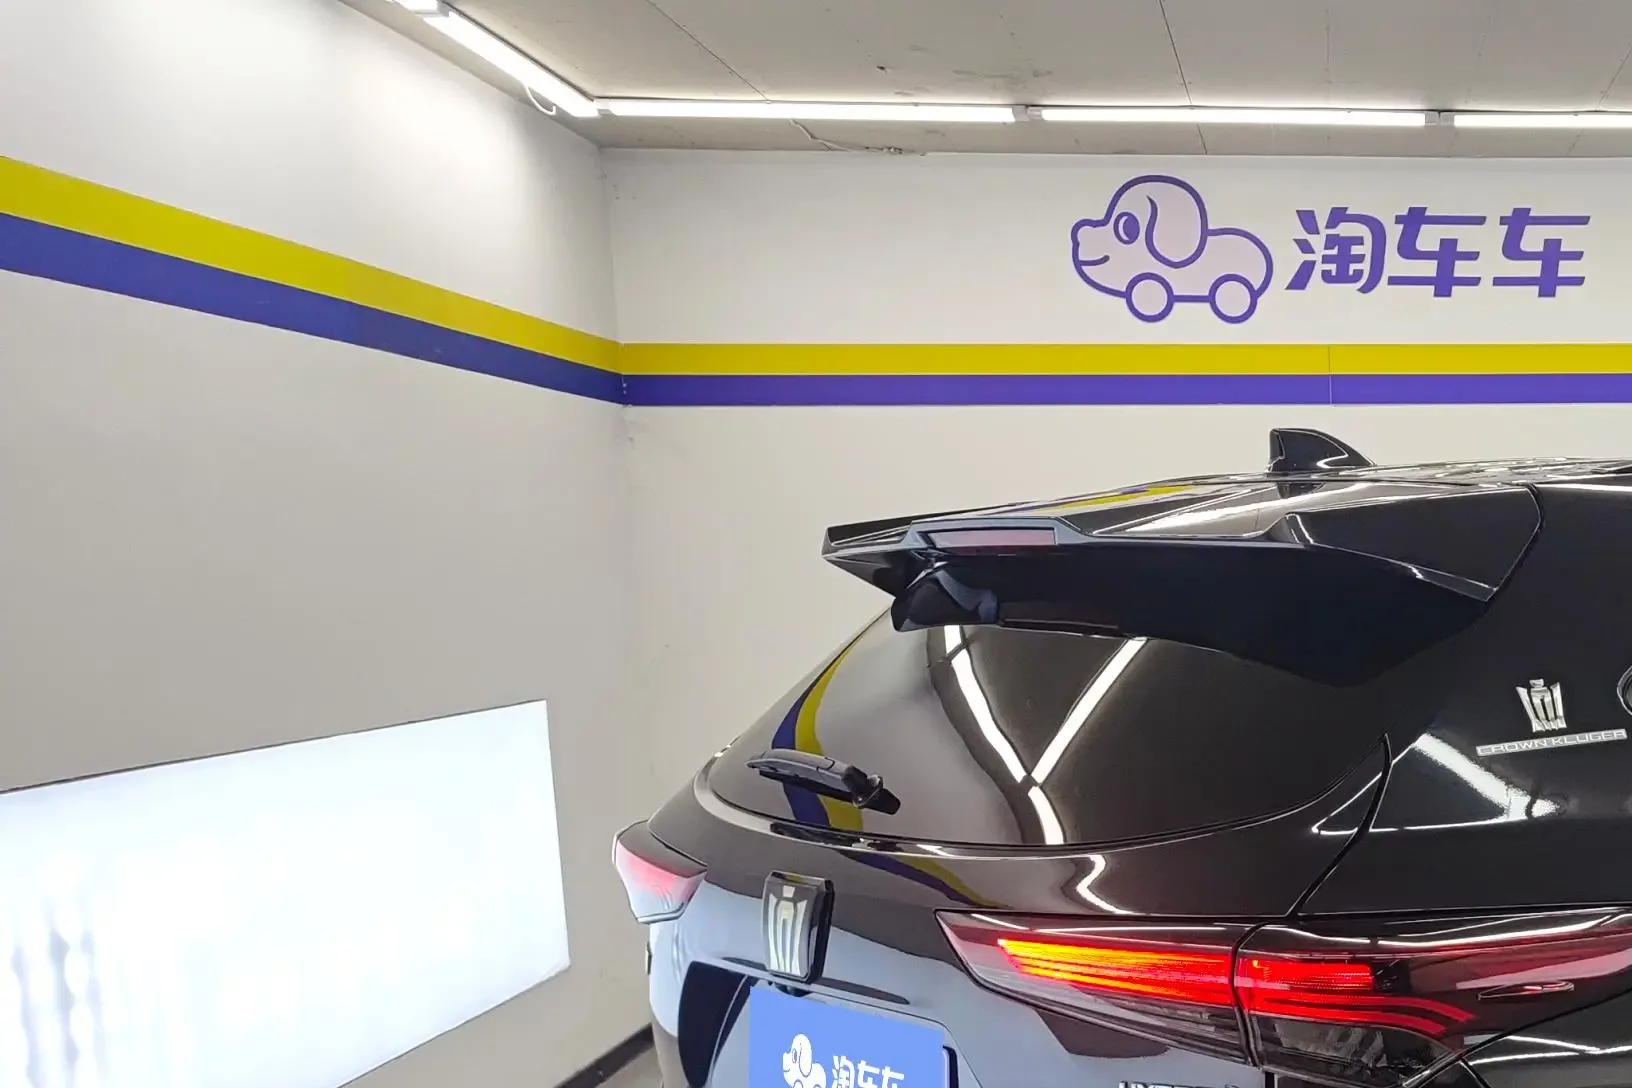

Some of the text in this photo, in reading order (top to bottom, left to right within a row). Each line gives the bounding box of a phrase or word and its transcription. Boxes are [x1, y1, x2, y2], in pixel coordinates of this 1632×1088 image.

[1284, 205, 1592, 298] 淘车车
[1477, 729, 1627, 756] CROWN KLUGER
